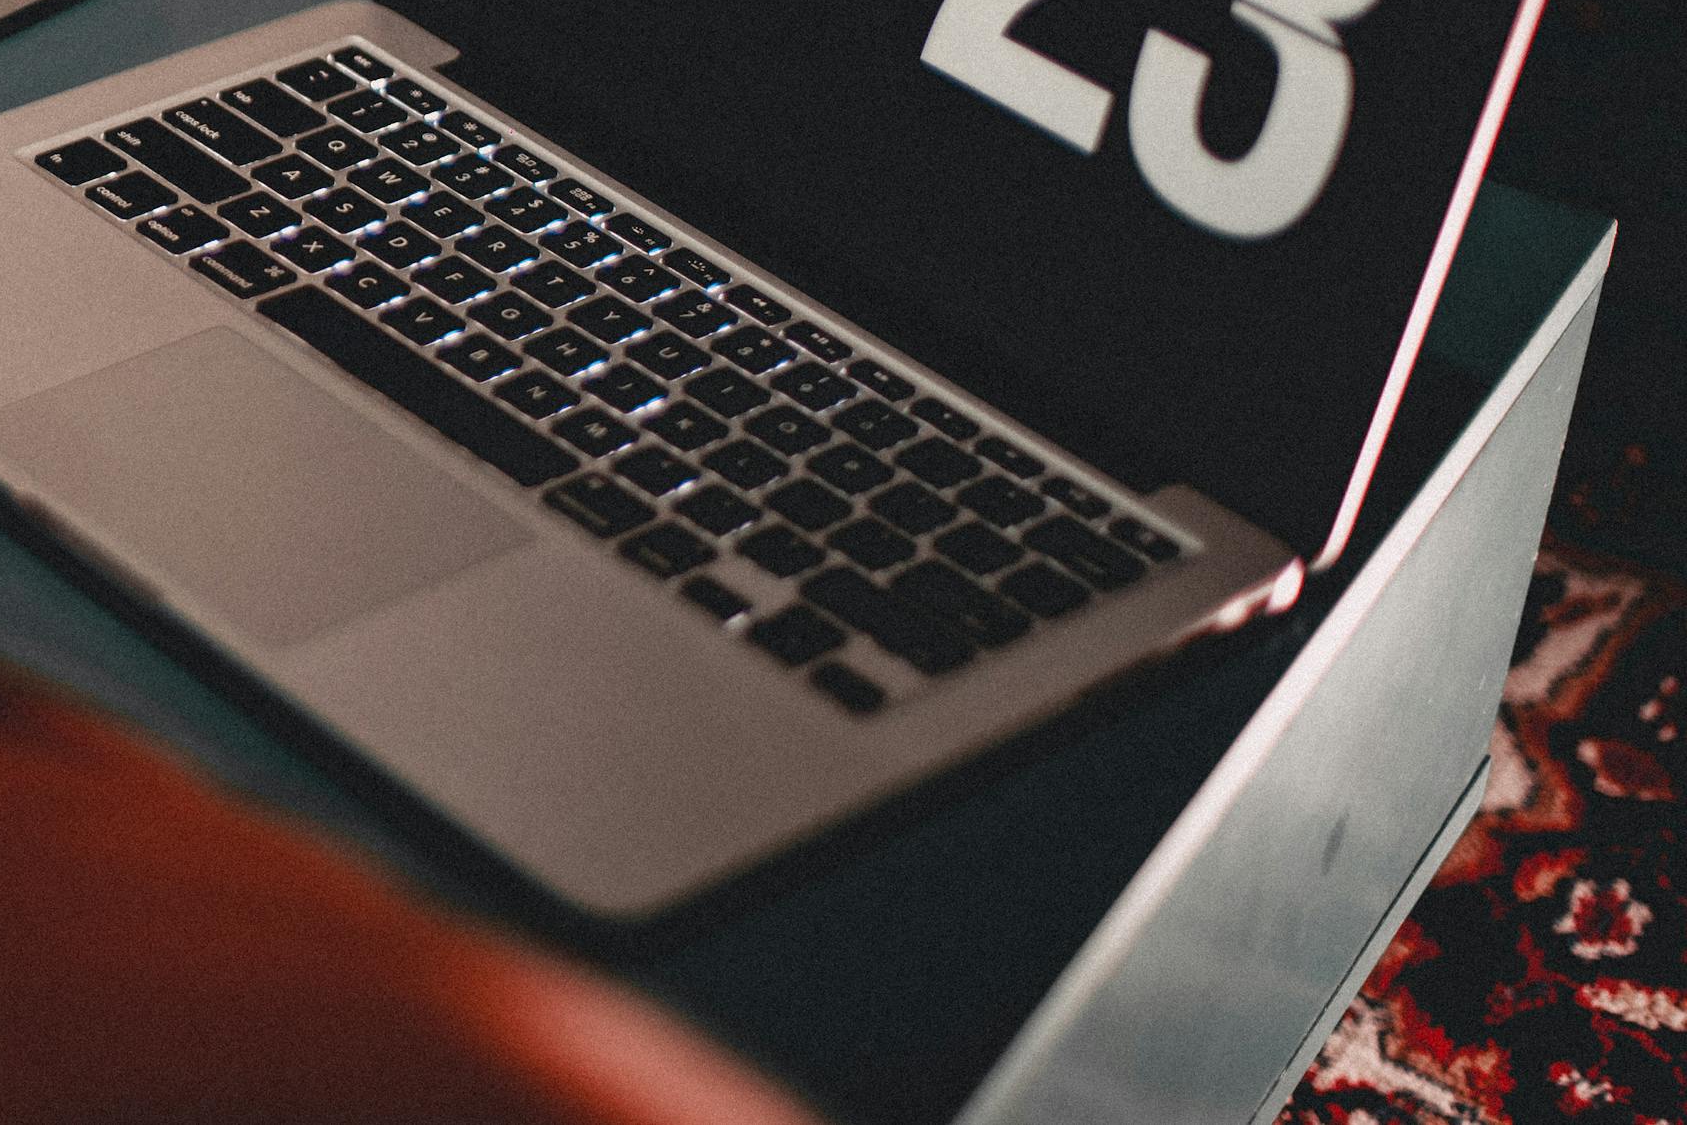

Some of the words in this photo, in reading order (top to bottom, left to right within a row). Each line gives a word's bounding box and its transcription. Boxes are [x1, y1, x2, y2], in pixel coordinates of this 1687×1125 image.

[233, 90, 252, 104] tab
[352, 107, 366, 116] 1
[175, 110, 200, 127] caps
[198, 121, 221, 140] lock
[117, 131, 142, 146] shift
[401, 139, 419, 149] 2
[327, 139, 347, 153] Q
[49, 153, 63, 164] fn
[281, 170, 301, 181] A
[378, 170, 402, 185] W
[454, 172, 472, 182] 3
[96, 186, 133, 209] control
[527, 199, 544, 208] $
[249, 206, 271, 218] Z
[335, 202, 354, 213] S
[433, 206, 452, 217] E
[510, 207, 526, 215] 4
[148, 220, 180, 242] option
[583, 230, 600, 244] %
[302, 240, 324, 253] X
[388, 236, 408, 248] D
[487, 240, 507, 252] R
[564, 240, 582, 249] 5
[202, 256, 254, 288] command
[444, 272, 464, 281] F
[358, 276, 378, 289] C
[547, 276, 564, 285] T
[620, 275, 636, 284] 6
[414, 311, 434, 323] V
[500, 307, 521, 320] G
[603, 310, 621, 321] Y
[555, 342, 578, 356] H
[658, 346, 680, 359] U
[527, 385, 547, 400] N
